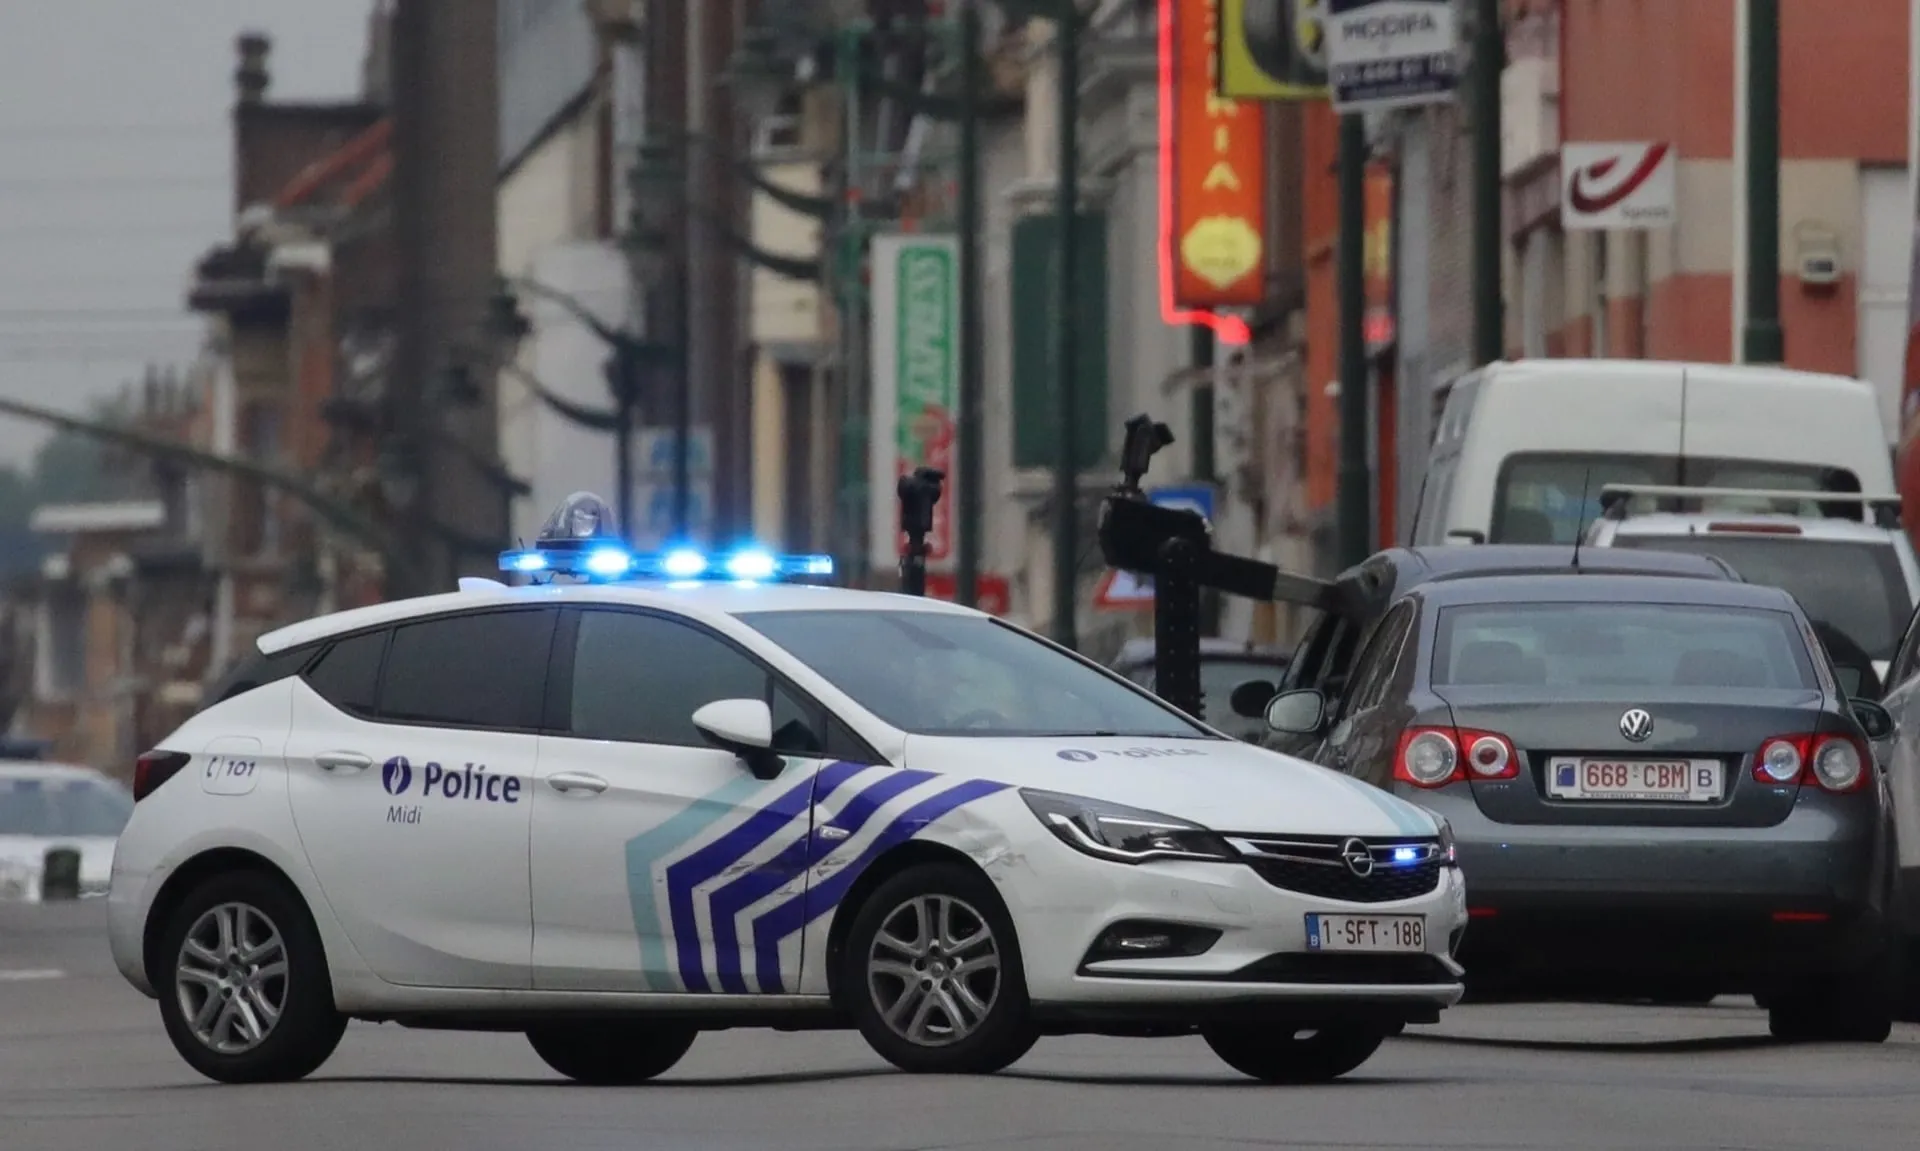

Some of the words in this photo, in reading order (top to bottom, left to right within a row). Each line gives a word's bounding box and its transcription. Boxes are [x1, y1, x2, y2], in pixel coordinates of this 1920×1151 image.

[226, 760, 256, 777] 101
[1697, 768, 1712, 787] B
[423, 761, 521, 804] Police
[386, 805, 423, 825] Midi
[1310, 934, 1319, 947] B
